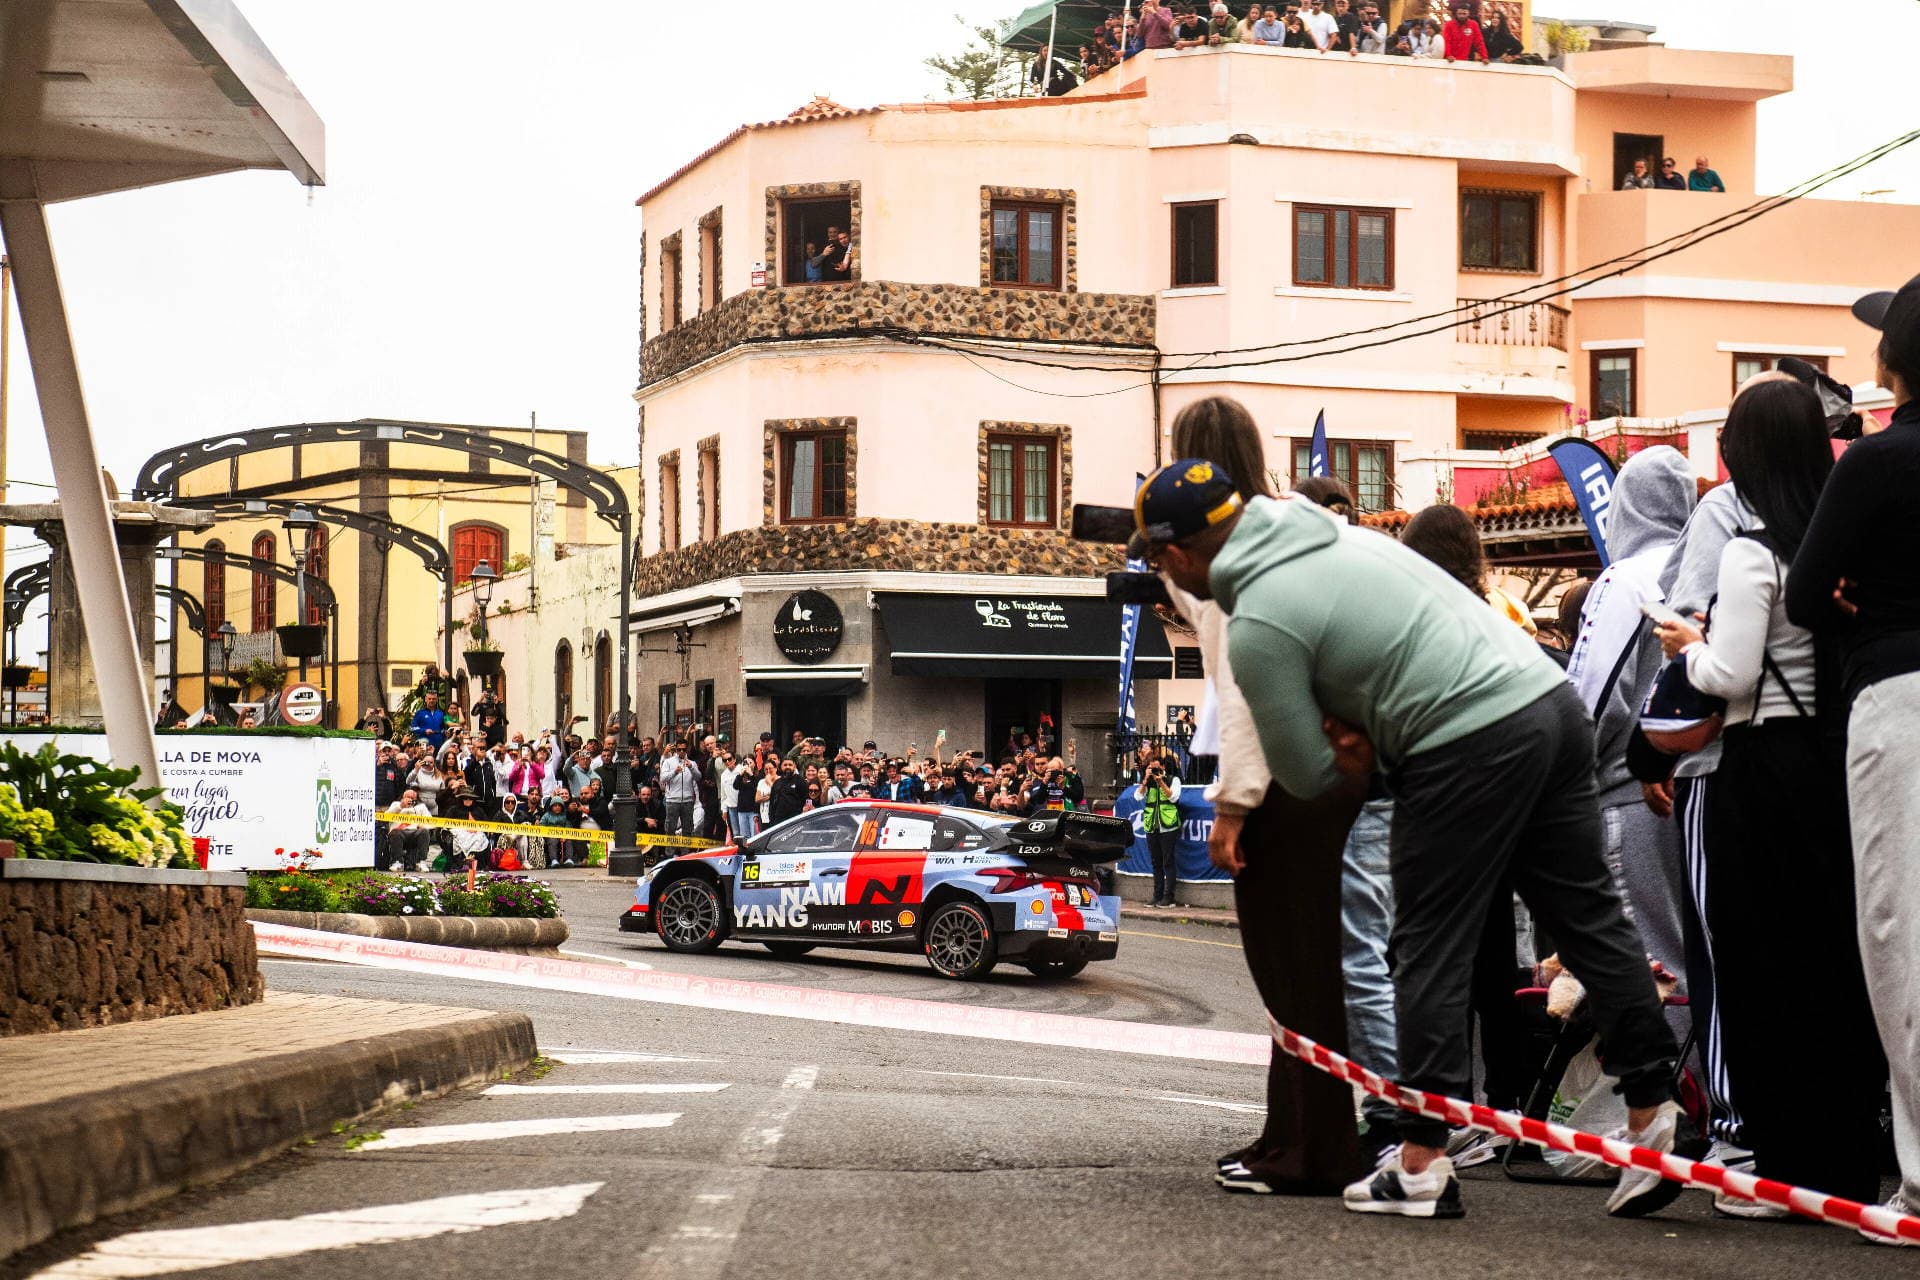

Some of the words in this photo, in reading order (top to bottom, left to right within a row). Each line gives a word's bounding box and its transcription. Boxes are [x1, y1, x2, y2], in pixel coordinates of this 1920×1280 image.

[191, 751, 212, 763] DE
[217, 751, 262, 763] MOYA
[171, 787, 189, 799] un
[182, 800, 239, 834] ágico
[348, 804, 356, 823] de
[357, 803, 373, 826] Moya
[332, 827, 347, 843] Gran
[859, 820, 879, 845] 16
[208, 844, 234, 855] RTE
[744, 864, 760, 880] 16
[780, 882, 846, 906] NAM
[733, 904, 809, 929] YANG
[848, 919, 893, 934] MOBIS
